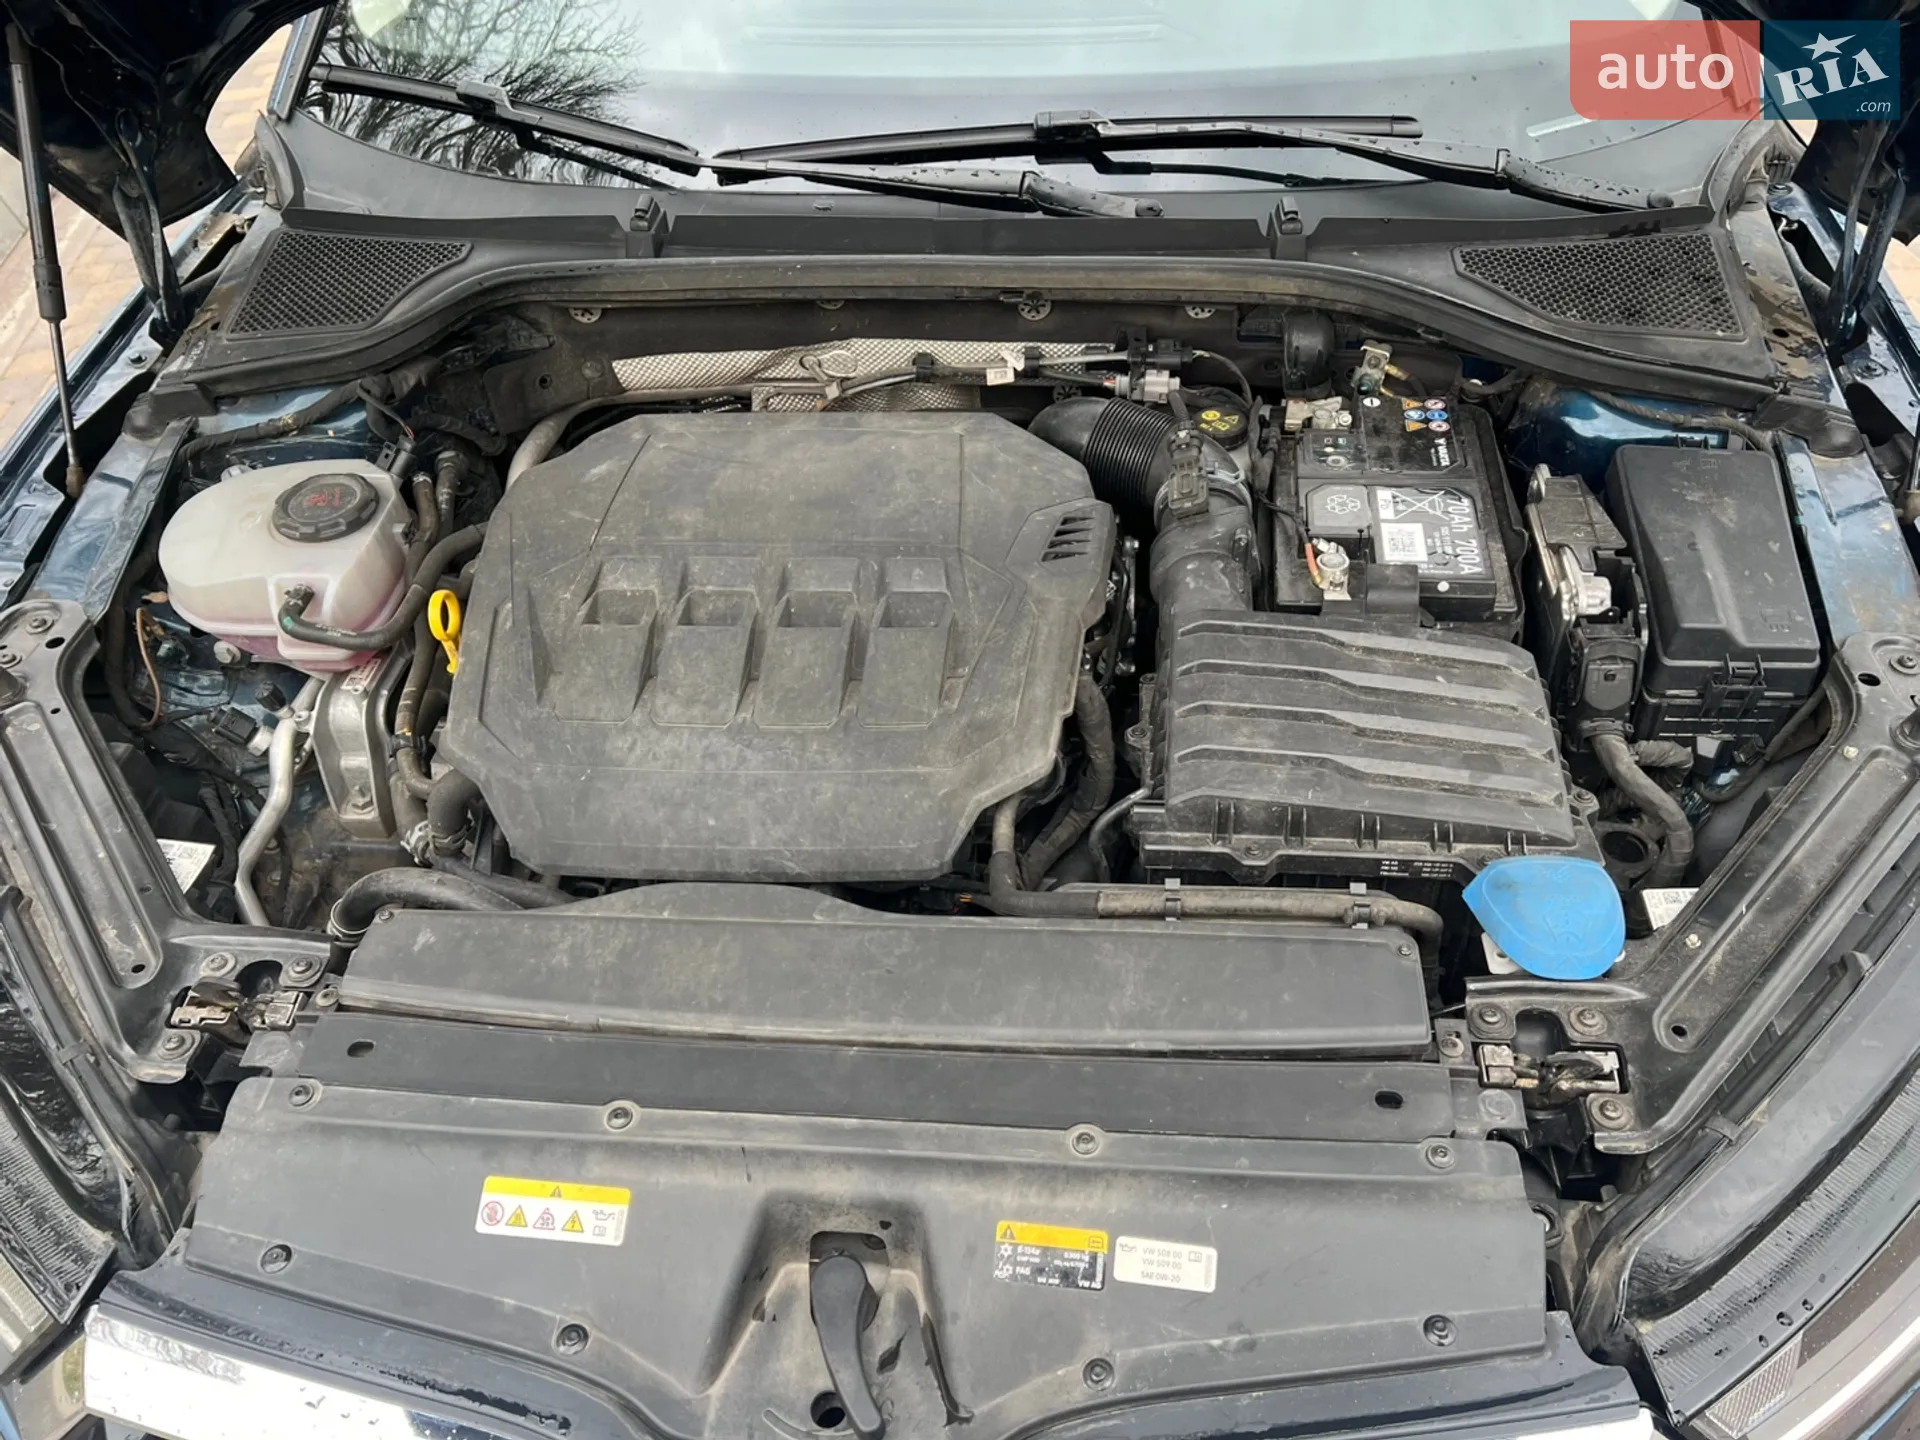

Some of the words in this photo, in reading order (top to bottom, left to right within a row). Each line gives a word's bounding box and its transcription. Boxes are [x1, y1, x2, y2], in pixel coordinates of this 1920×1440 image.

[1446, 498, 1473, 532] 70Ah
[1454, 539, 1482, 575] 700A
[1142, 1247, 1155, 1256] VW
[1157, 1248, 1171, 1258] 508
[1173, 1250, 1182, 1260] 00
[1142, 1258, 1154, 1266] VW
[1156, 1259, 1170, 1268] 509
[1172, 1261, 1182, 1270] 00
[1141, 1271, 1154, 1280] SAE
[1155, 1273, 1181, 1284] 0W-20
